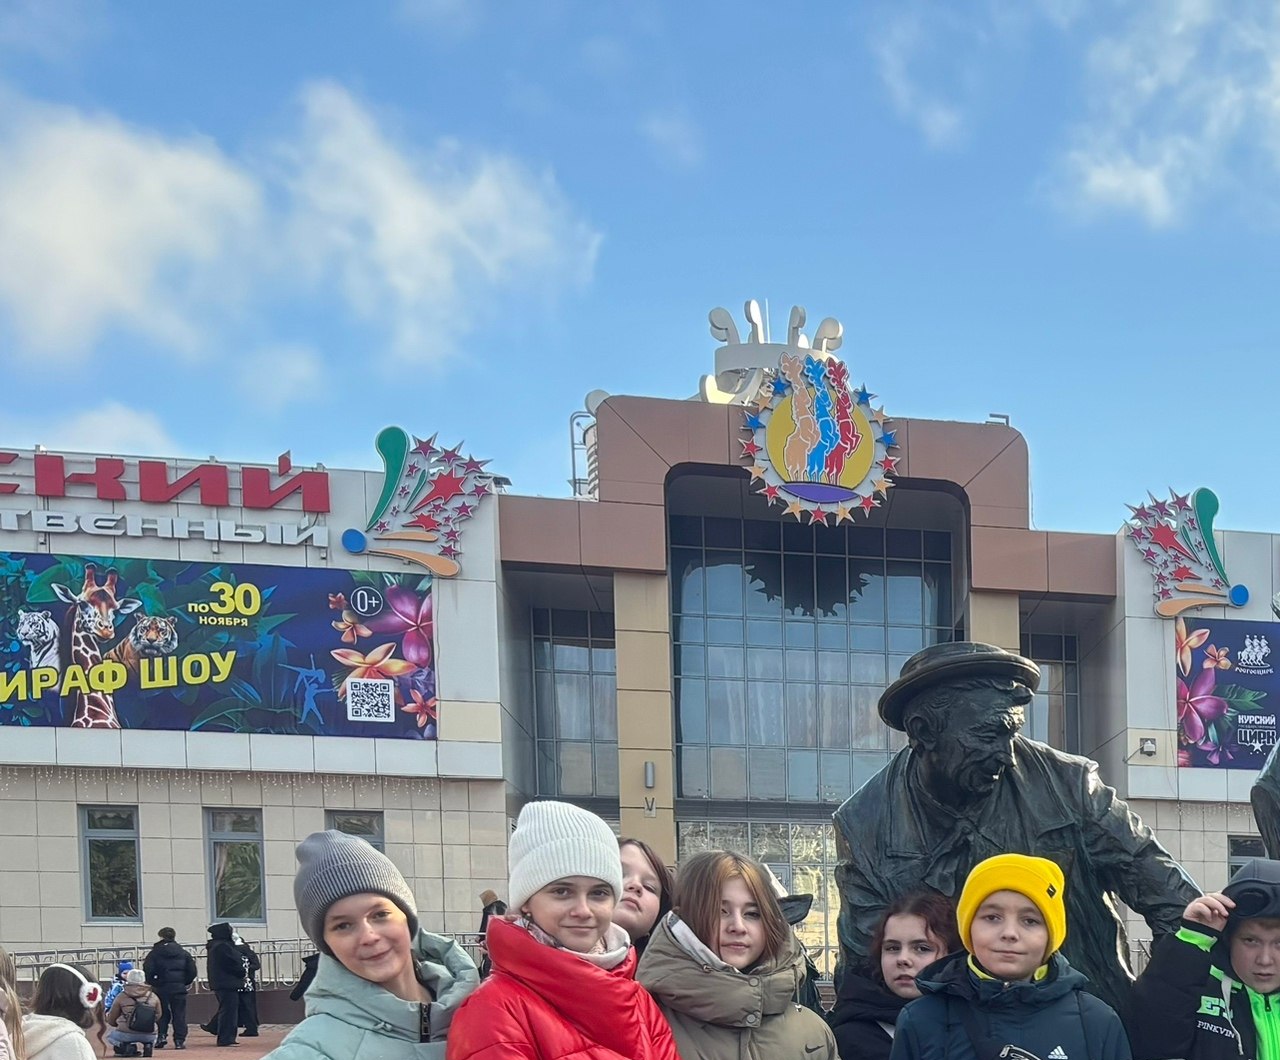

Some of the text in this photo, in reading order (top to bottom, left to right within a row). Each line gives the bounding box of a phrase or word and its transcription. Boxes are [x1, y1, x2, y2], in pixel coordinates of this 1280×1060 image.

[0, 450, 331, 513] КИЙ
[187, 582, 261, 616] по 30
[357, 591, 380, 612] 0+
[199, 616, 248, 627] НОЯБРЯ
[140, 651, 236, 689] ШОУ
[1238, 714, 1276, 725] КУРСКИЙ
[1238, 729, 1277, 746] ЦИРК
